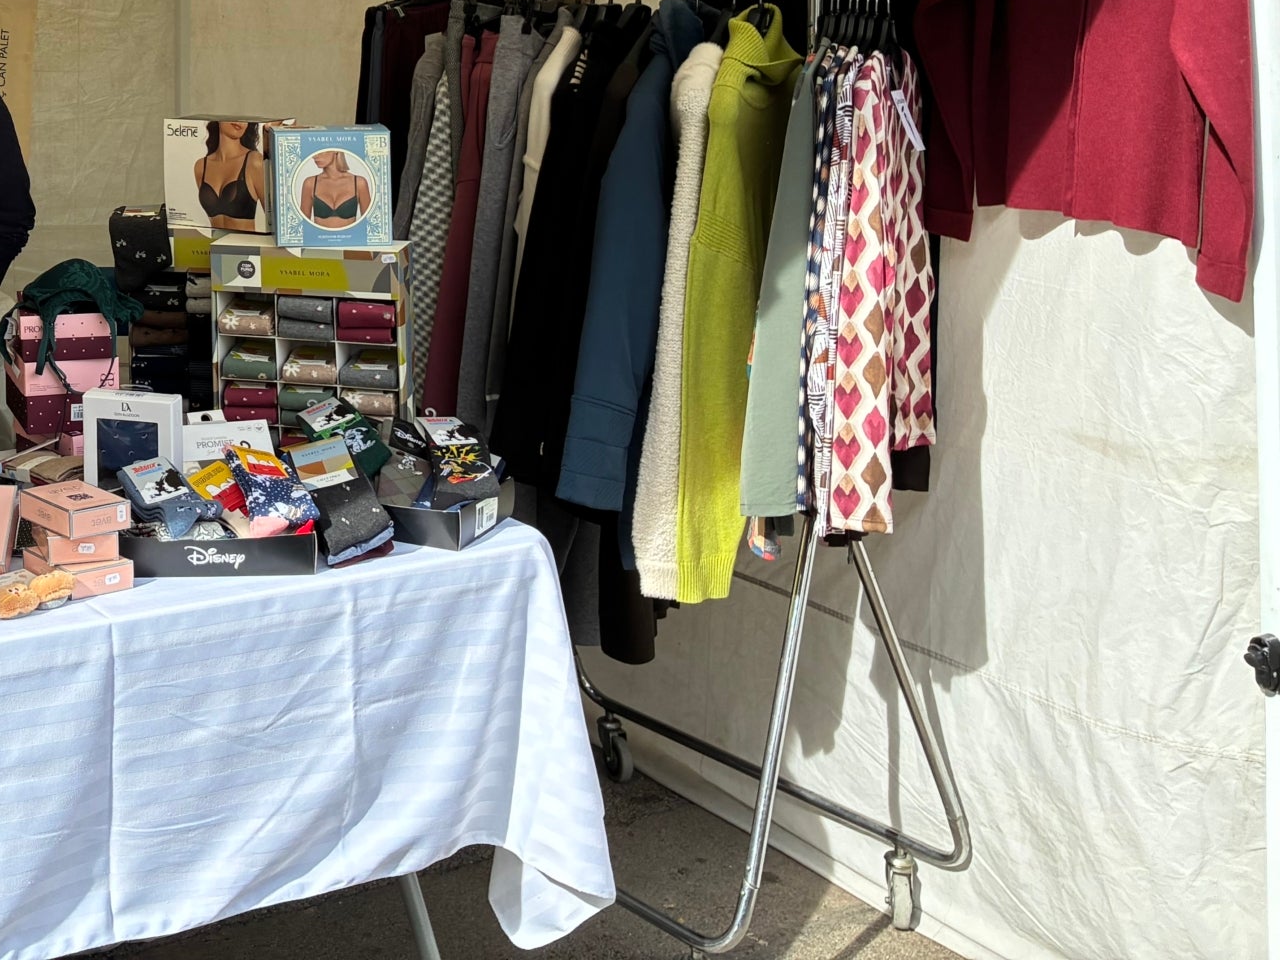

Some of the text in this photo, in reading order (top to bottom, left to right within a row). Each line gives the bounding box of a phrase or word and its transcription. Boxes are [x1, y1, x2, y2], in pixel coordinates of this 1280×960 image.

[0, 28, 10, 59] PALET
[280, 269, 306, 277] YSABEL
[183, 545, 246, 570] Disney
